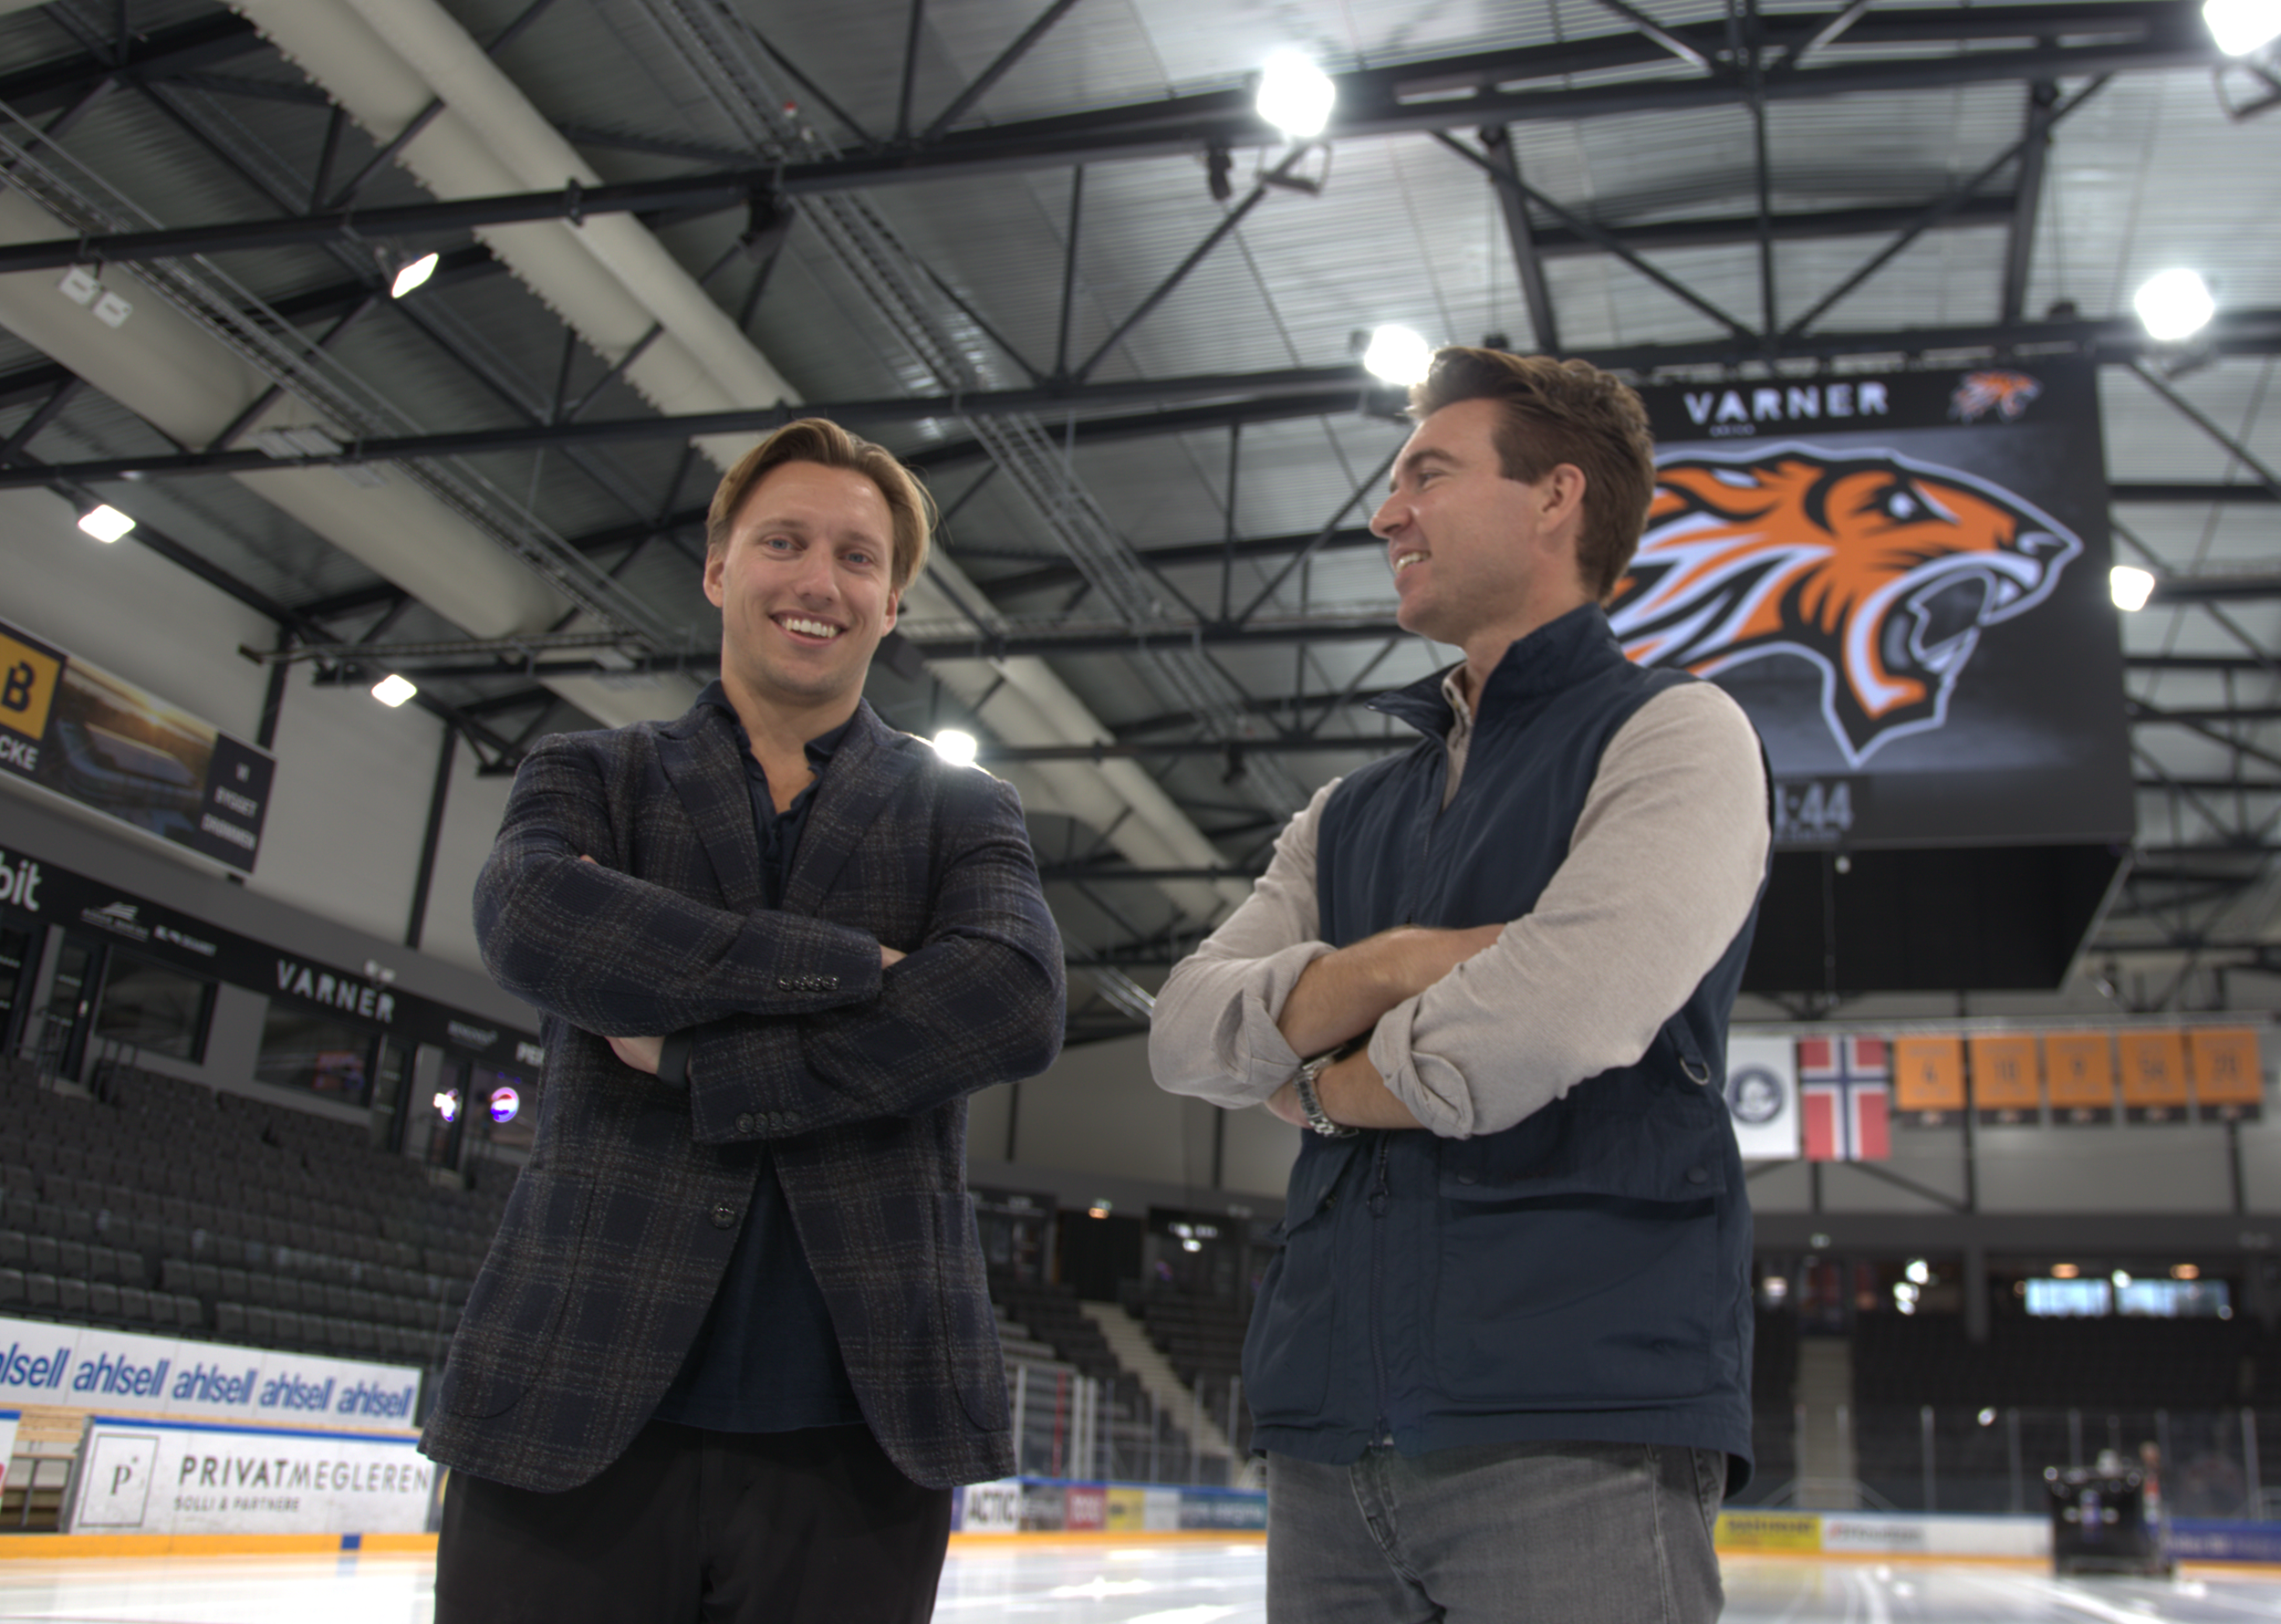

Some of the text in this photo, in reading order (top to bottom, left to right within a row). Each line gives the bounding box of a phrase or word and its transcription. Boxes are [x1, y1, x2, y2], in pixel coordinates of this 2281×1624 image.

[1683, 381, 1889, 425] VARNER
[1, 660, 35, 713] B
[276, 958, 396, 1023] VARNER
[0, 1342, 71, 1390] lsell
[72, 1352, 171, 1399] ahlsell
[172, 1363, 258, 1406] ahlsell
[258, 1371, 337, 1412] ahlsell
[336, 1376, 415, 1419] ahlsell
[178, 1455, 431, 1494] PRIVATMEGLEREN
